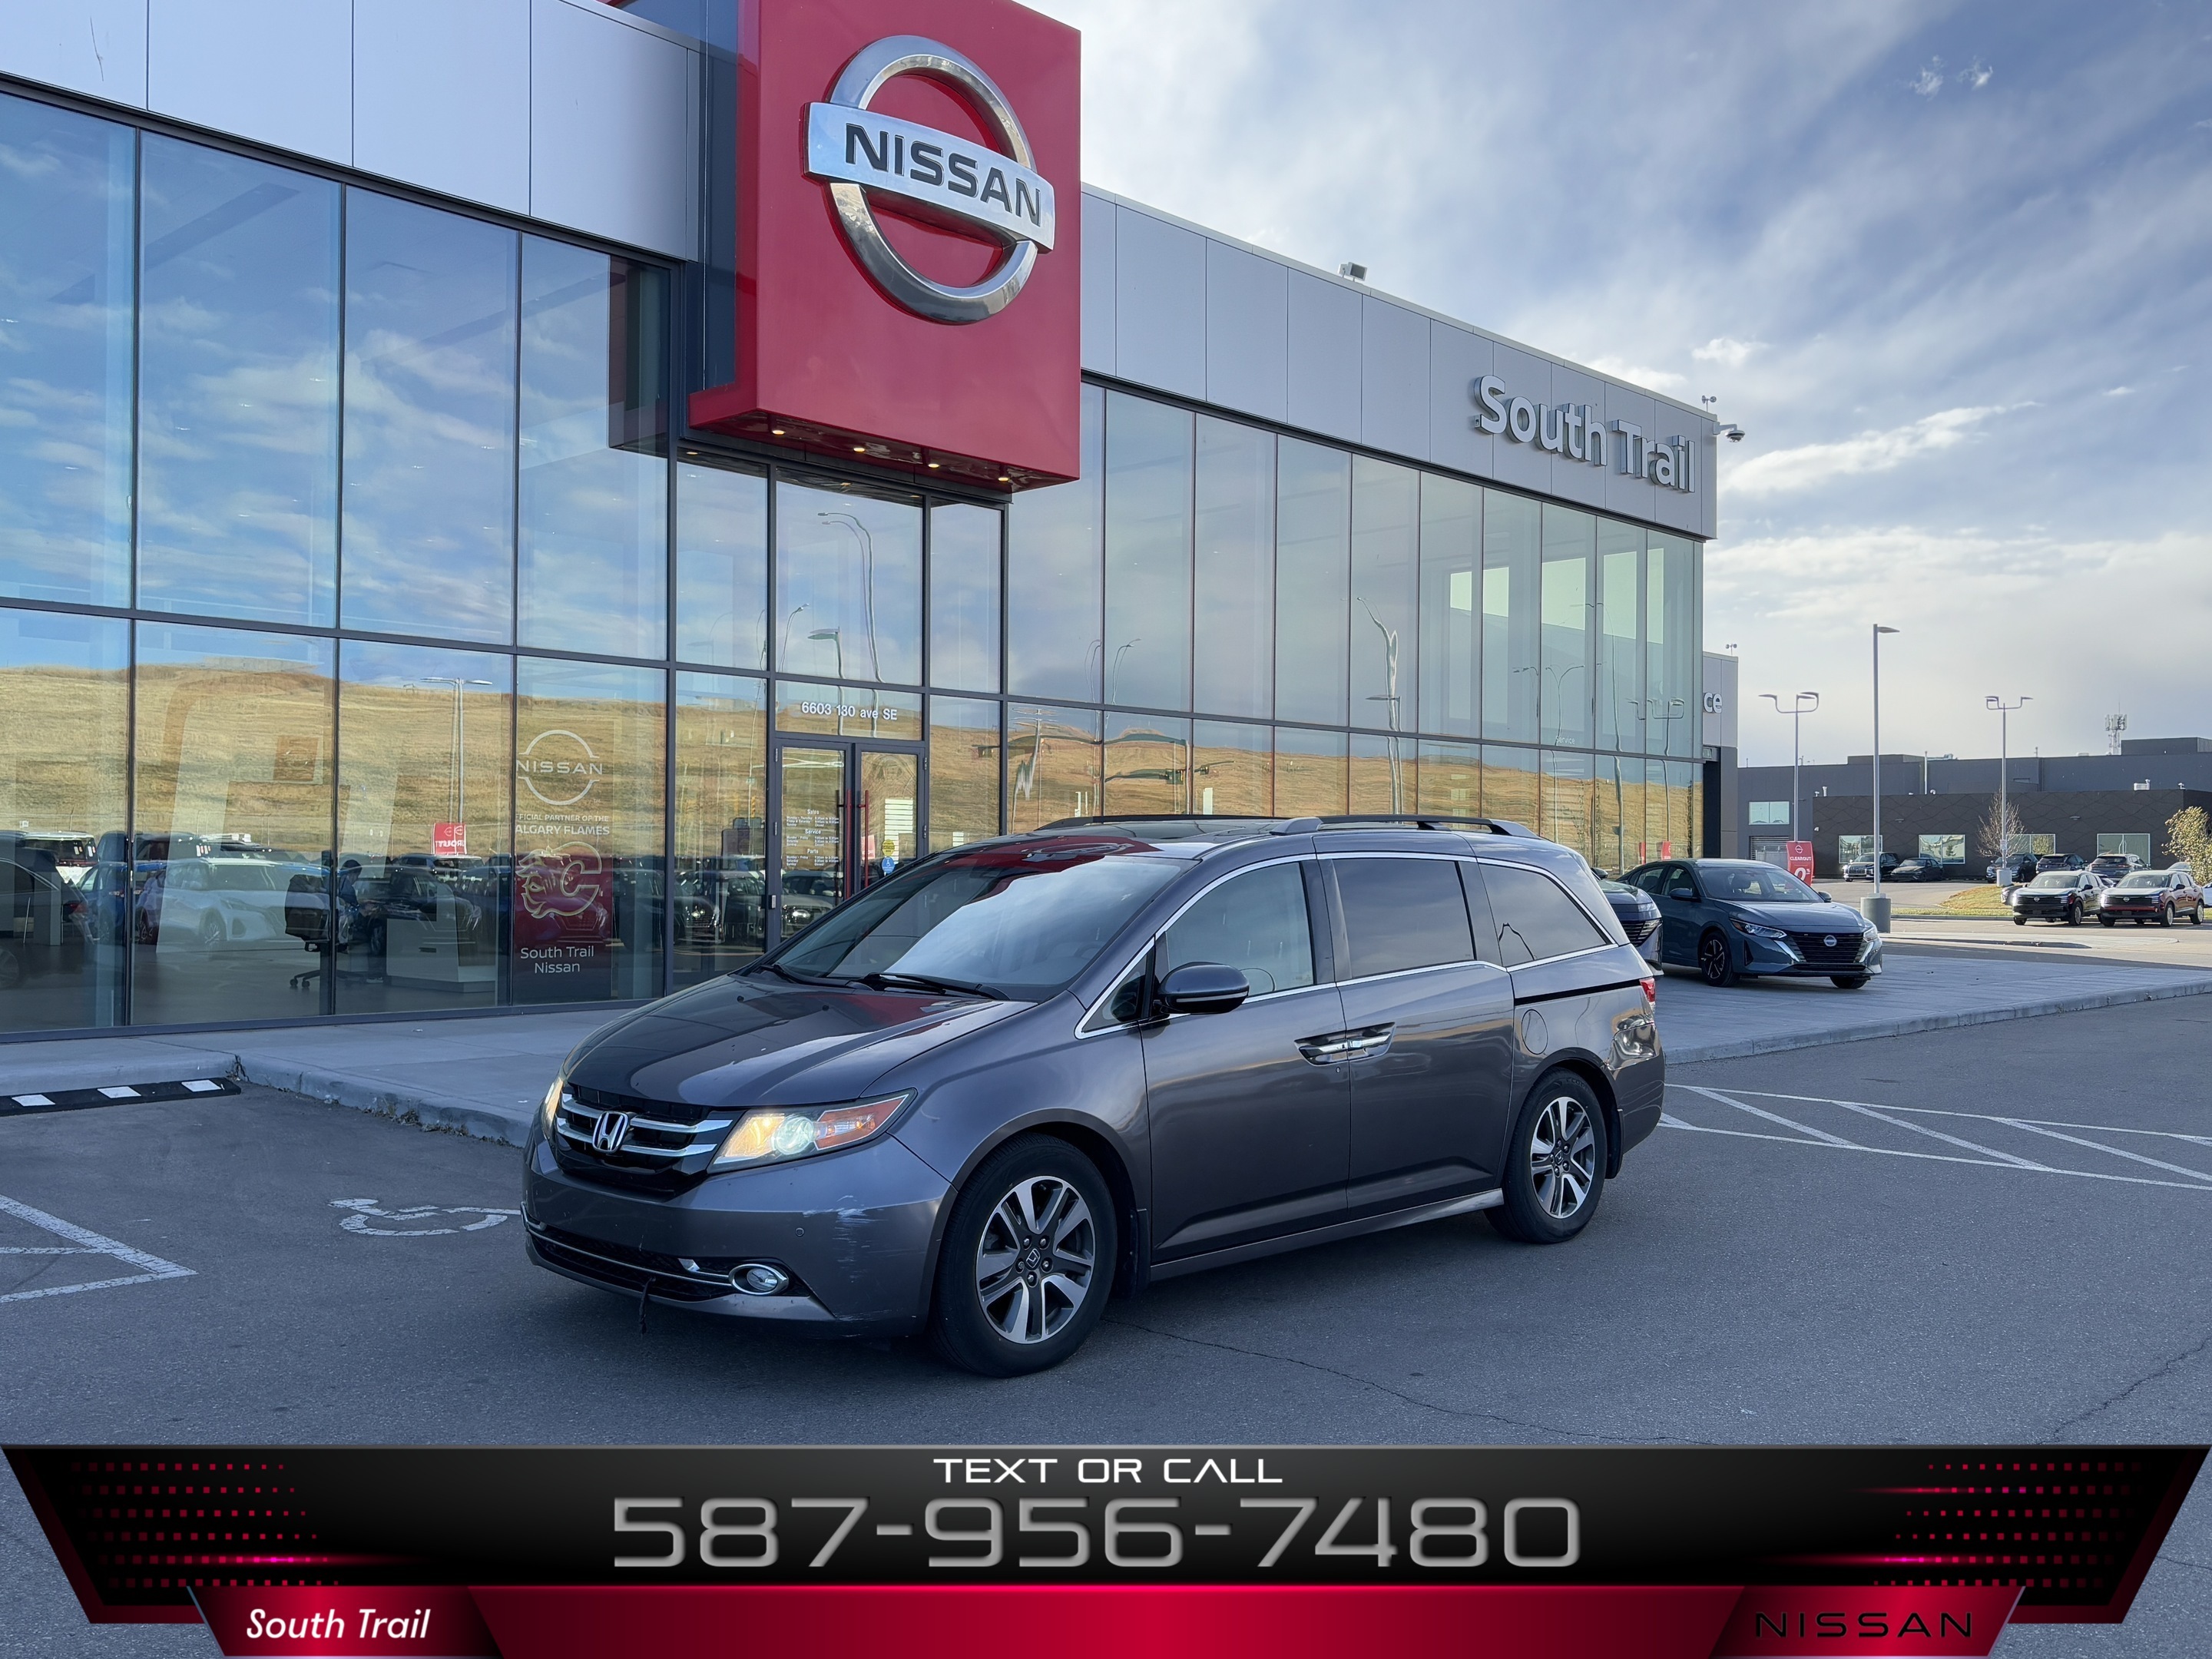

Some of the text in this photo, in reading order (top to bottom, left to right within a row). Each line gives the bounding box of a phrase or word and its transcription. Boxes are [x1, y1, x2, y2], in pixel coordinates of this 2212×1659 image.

[846, 123, 1041, 227] NISSAN
[1474, 375, 1695, 492] South Trail
[802, 701, 832, 715] 6603
[860, 708, 879, 719] ave
[883, 707, 898, 720] SE
[515, 760, 603, 775] NISSAN
[515, 824, 610, 836] ALGARY FLAMES
[520, 945, 594, 959] South Trail
[535, 962, 581, 974] Nissan
